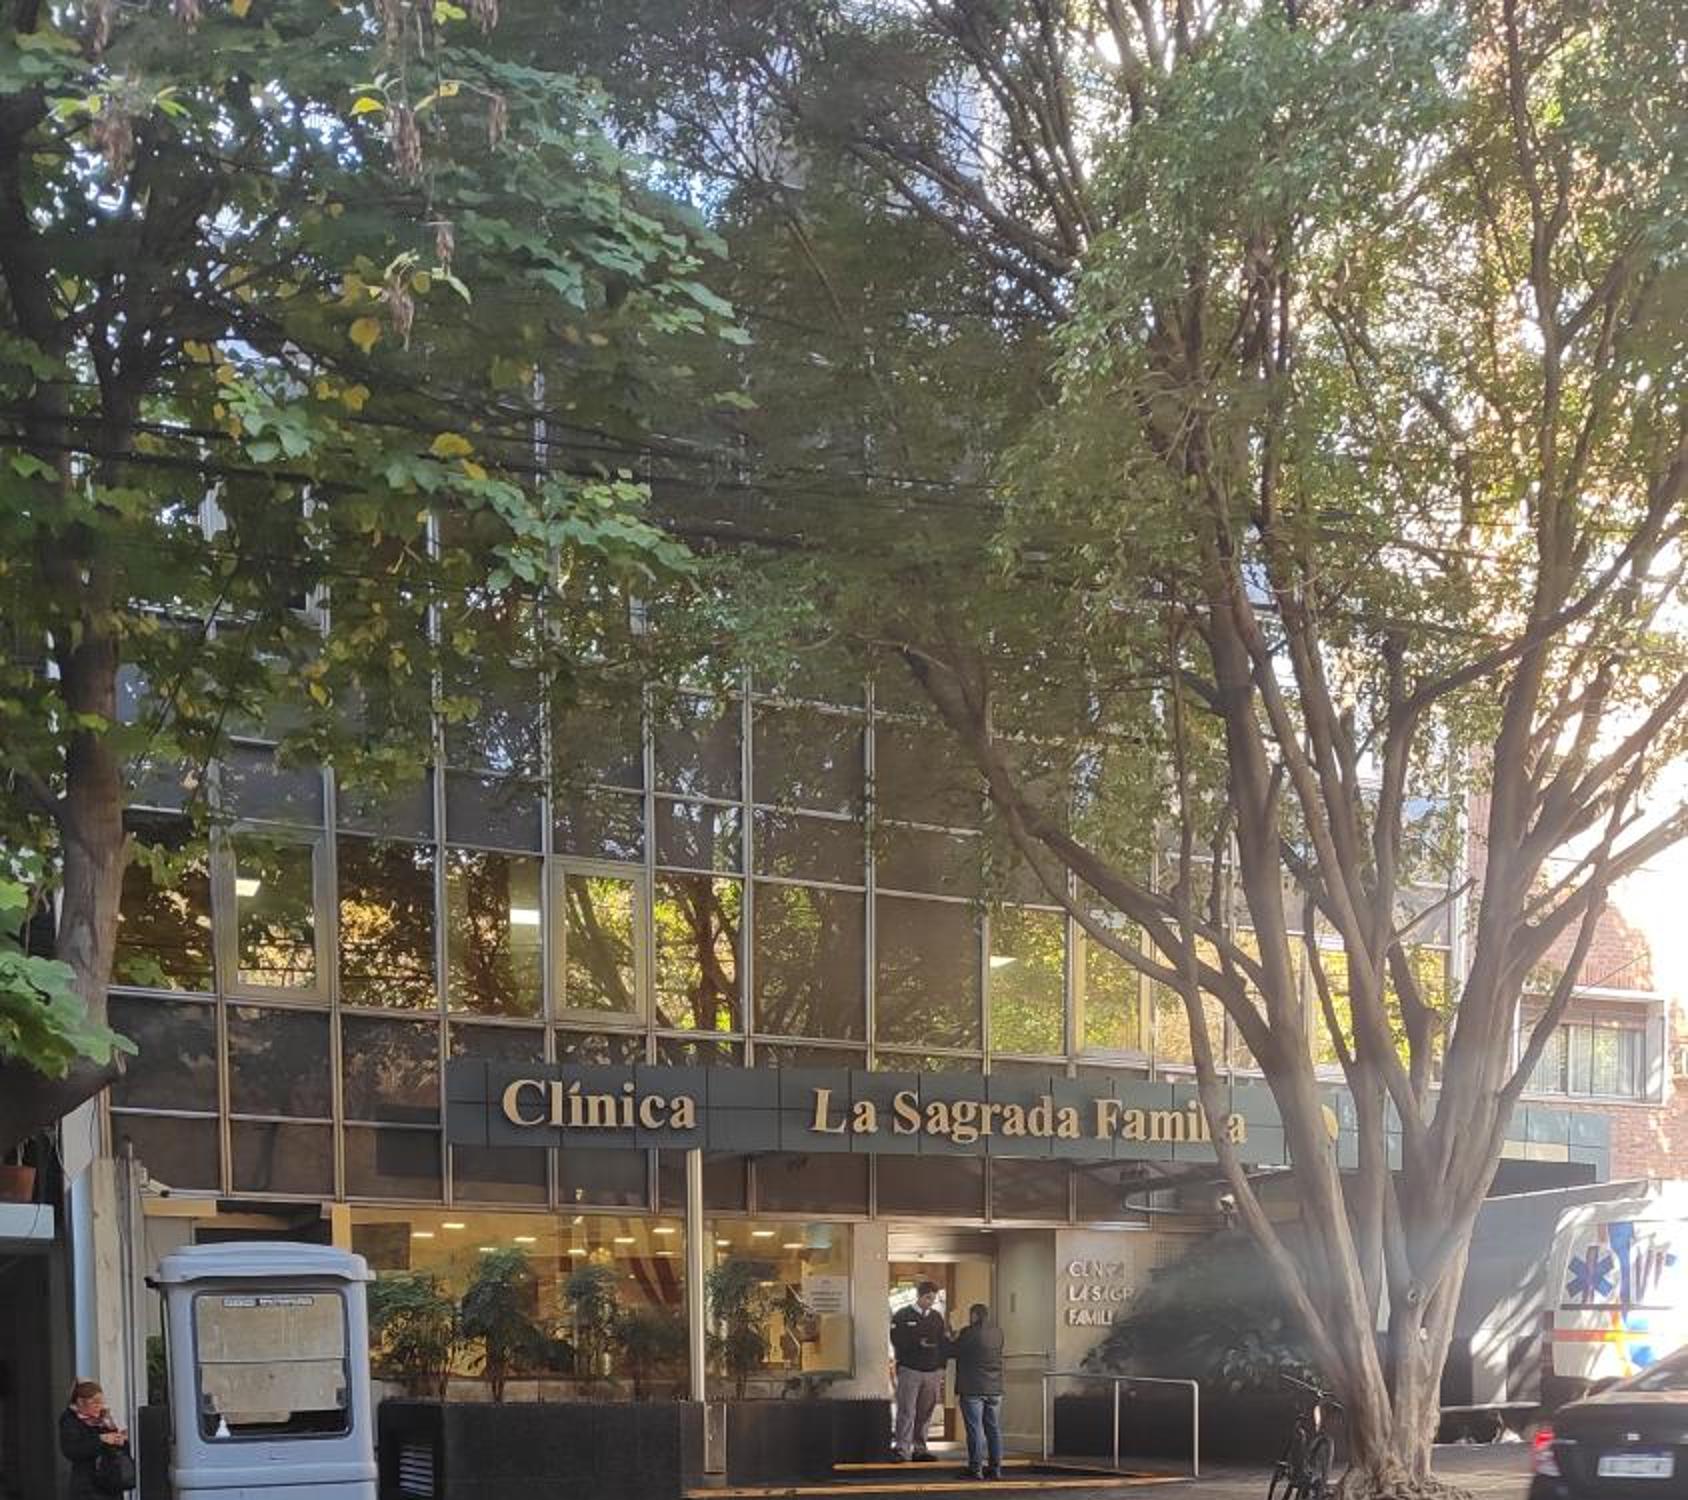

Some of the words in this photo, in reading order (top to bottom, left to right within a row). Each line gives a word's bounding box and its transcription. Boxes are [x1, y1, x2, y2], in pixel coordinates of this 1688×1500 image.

[503, 1078, 697, 1130] Clínica
[809, 1088, 878, 1135] La
[893, 1090, 1081, 1144] Sagrada
[1094, 1098, 1247, 1146] Famila
